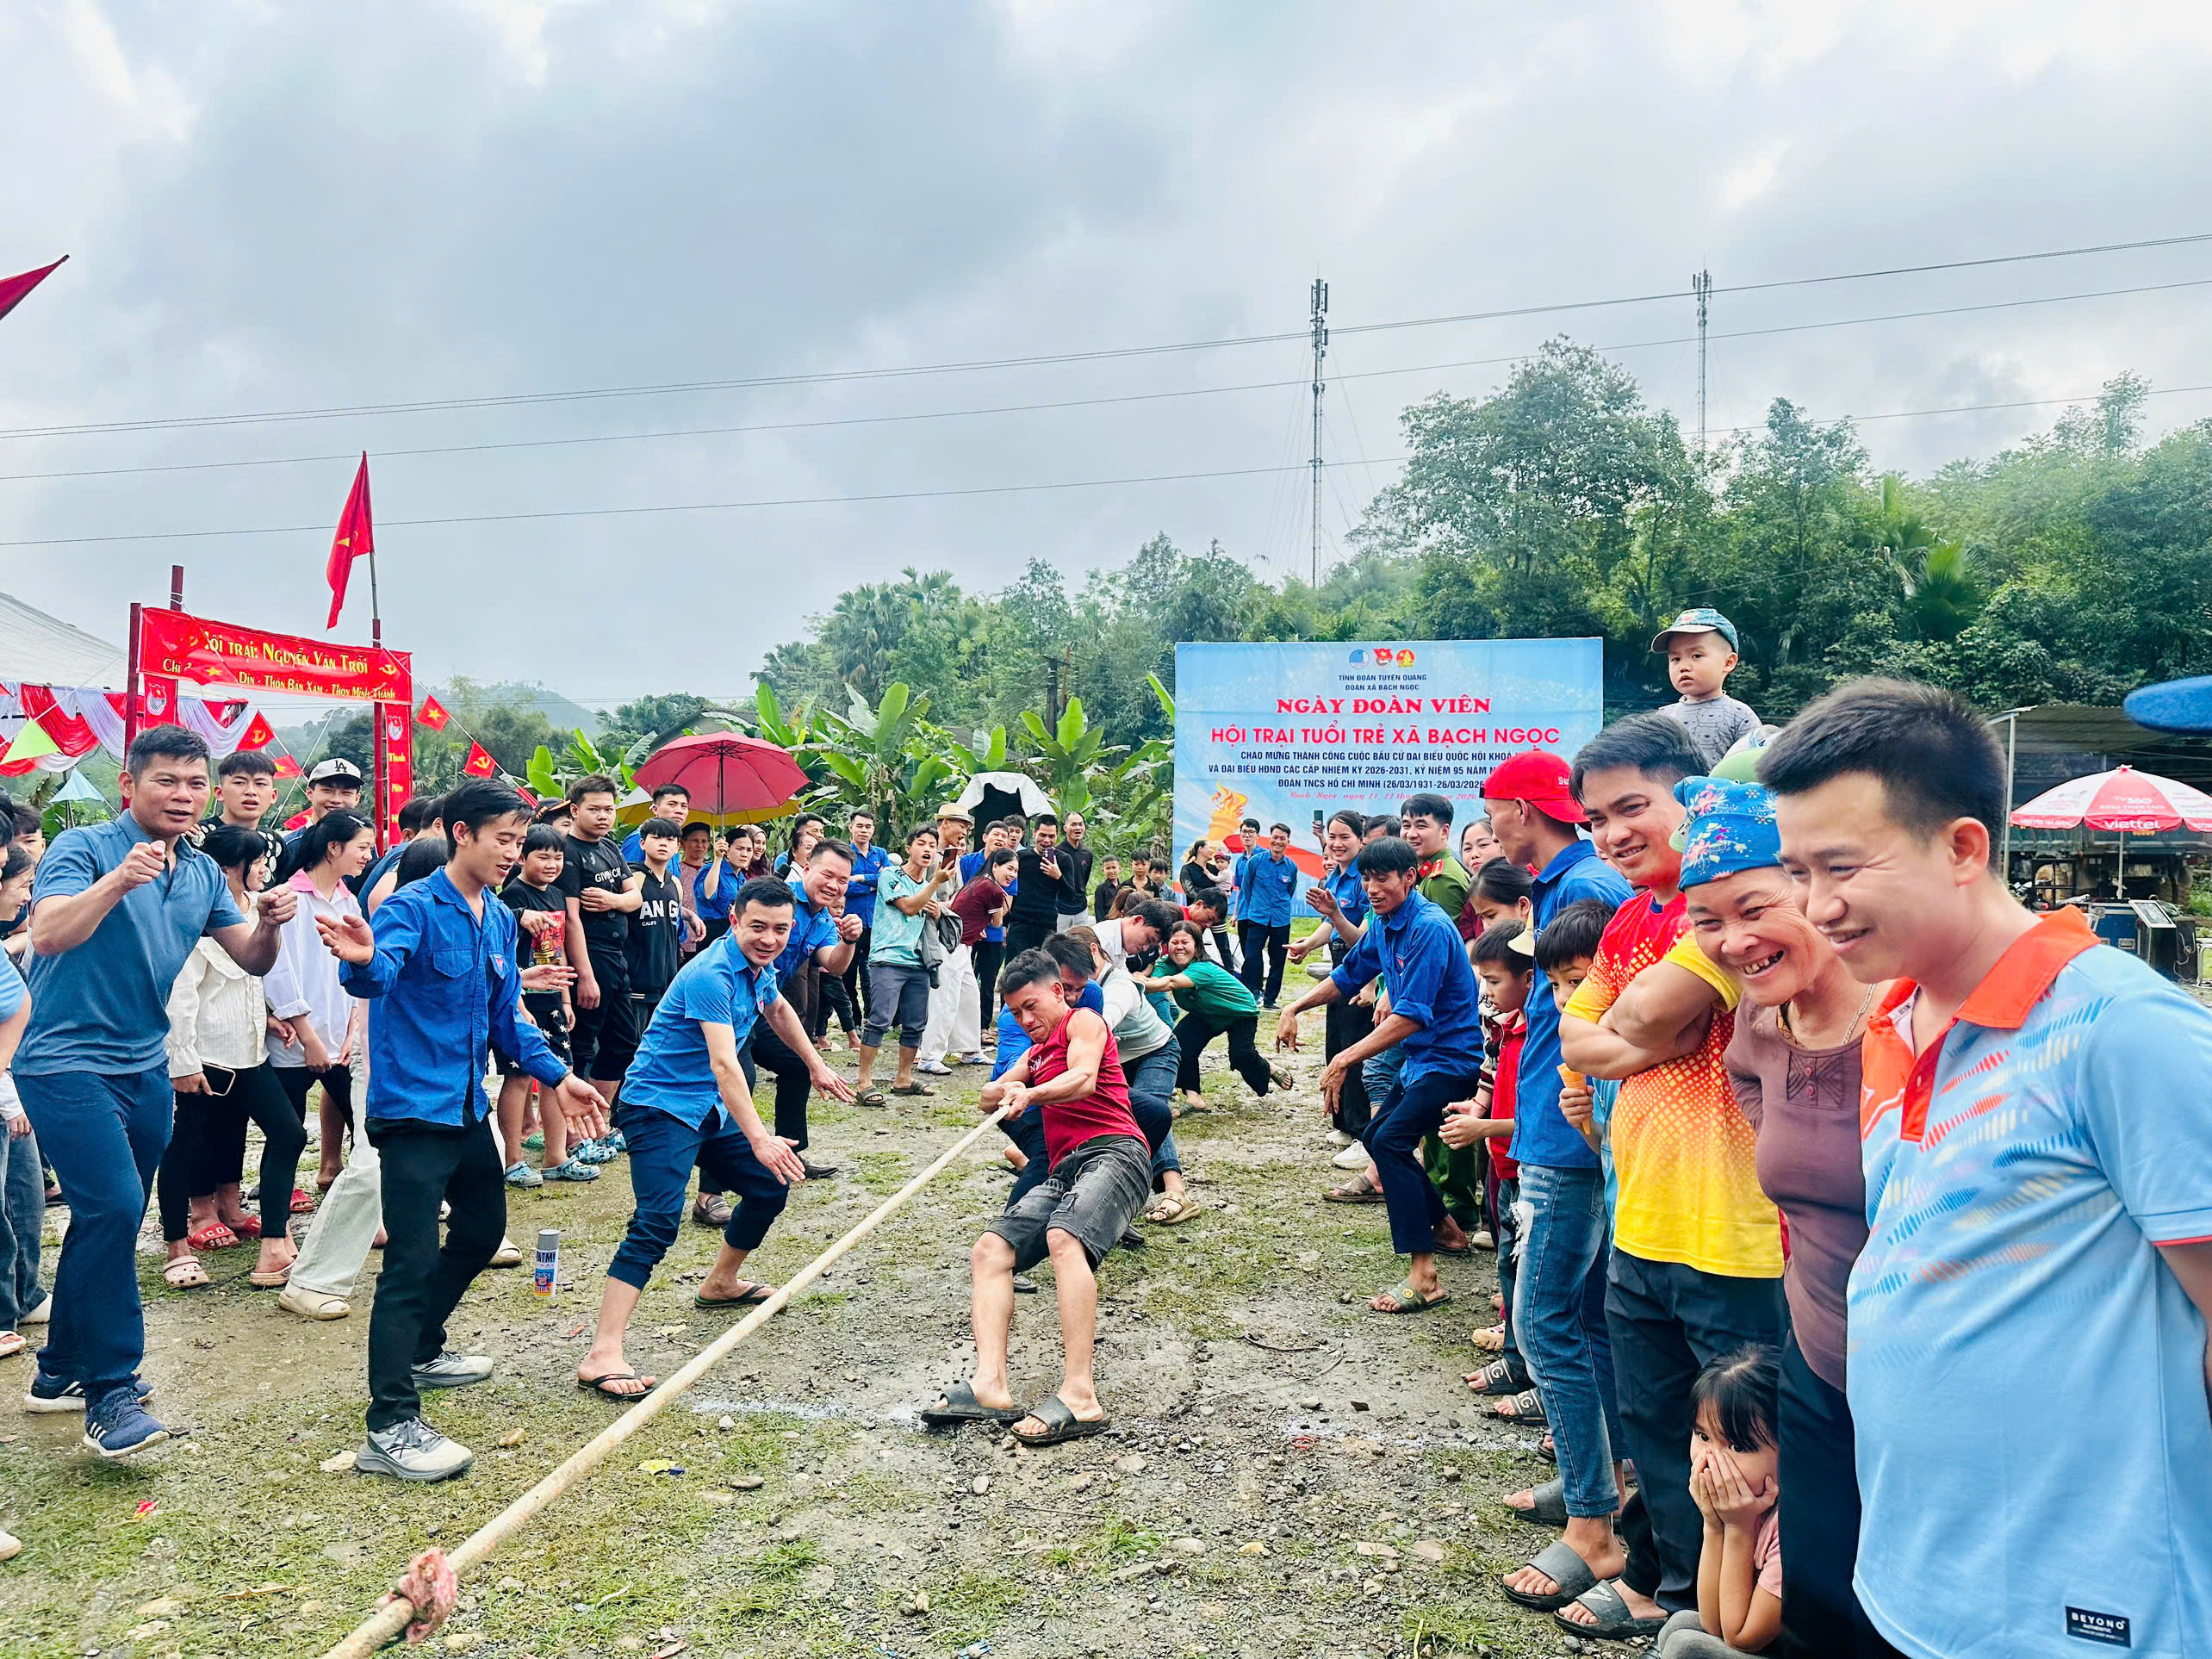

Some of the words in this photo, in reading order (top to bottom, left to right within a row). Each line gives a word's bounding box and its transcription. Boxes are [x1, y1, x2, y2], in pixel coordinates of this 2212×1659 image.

[1276, 695, 1345, 714] NGÀY
[1352, 695, 1423, 714] ĐOÀN
[1430, 694, 1491, 714] VIÊN
[1211, 724, 1246, 748] HỘI
[1252, 728, 1295, 749] TRẠI
[1301, 720, 1345, 744] TUỔI
[1352, 723, 1385, 744] TRẺ
[1392, 725, 1420, 744] XÃ
[1427, 728, 1486, 749] BẠCH
[1494, 727, 1560, 749] NGỌC
[1240, 750, 1263, 760] CHÀO
[1265, 750, 1290, 760] MỪNG
[1292, 751, 1320, 761] THÀNH
[1322, 750, 1345, 761] CÔNG
[1348, 751, 1370, 762] CUỘC
[1392, 749, 1405, 761] CỬ
[1406, 752, 1420, 762] ĐẠI
[1445, 750, 1469, 761] QUỐC
[1471, 750, 1486, 762] HỘI
[335, 760, 347, 773] LA
[1209, 763, 1219, 773] VÀ
[1221, 764, 1235, 774] ĐẠI
[1258, 765, 1281, 774] HĐND
[1283, 764, 1301, 774] CÁC
[1302, 762, 1320, 774] CẤP
[1322, 764, 1350, 775] NHIỆM
[1428, 765, 1451, 776] NIỆM
[1453, 766, 1463, 774] 95
[1278, 778, 1301, 787] ĐOÀN
[1303, 779, 1325, 788] TNCS
[1341, 779, 1356, 788] CHÍ
[1358, 780, 1381, 788] MINH
[2104, 819, 2161, 830] viettel
